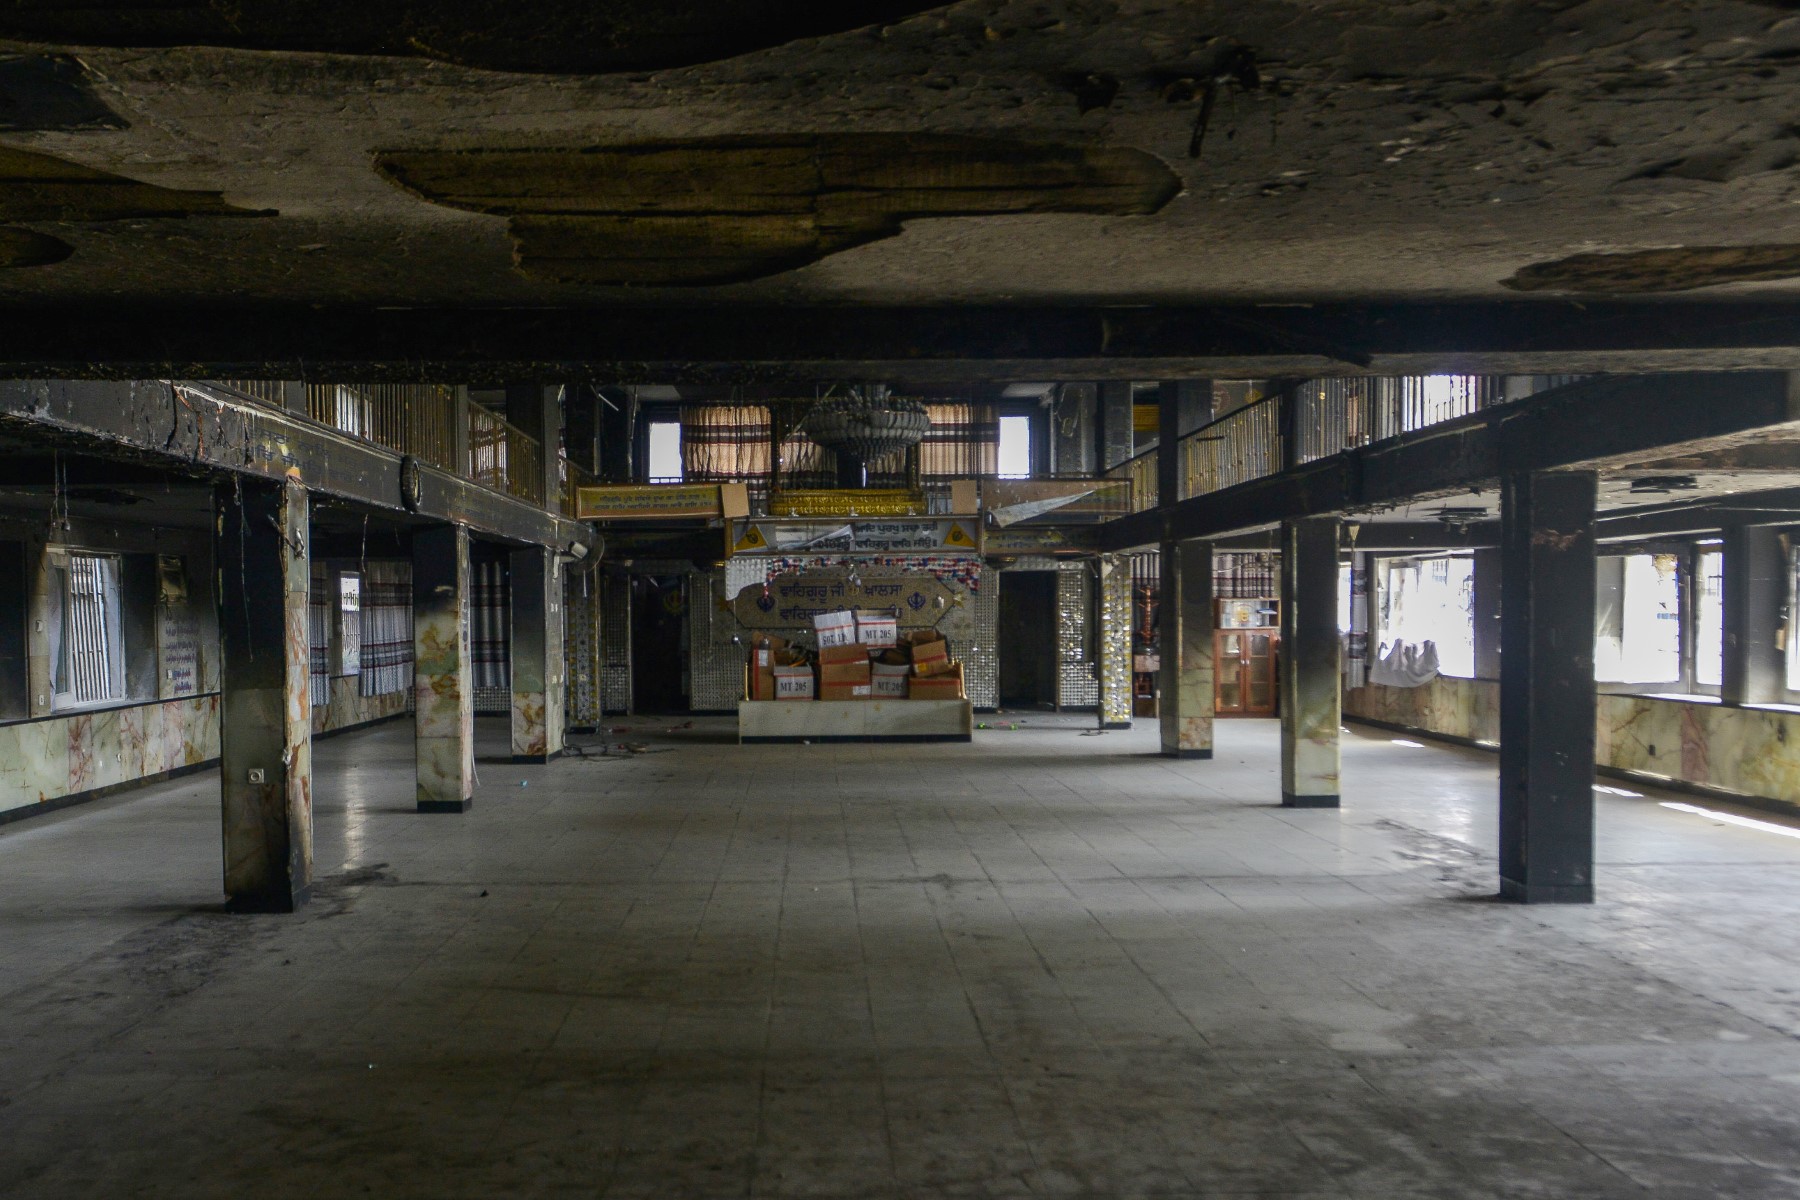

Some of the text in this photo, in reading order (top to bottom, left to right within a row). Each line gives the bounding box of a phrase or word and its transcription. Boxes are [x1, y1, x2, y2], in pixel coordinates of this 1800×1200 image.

[780, 581, 903, 604] ਵਾਹਿਗੁਰੂ ਜੀ ਖਾਲਸਾ
[865, 629, 892, 639] MT 205
[780, 681, 807, 692] MT 205
[877, 682, 890, 691] MT
